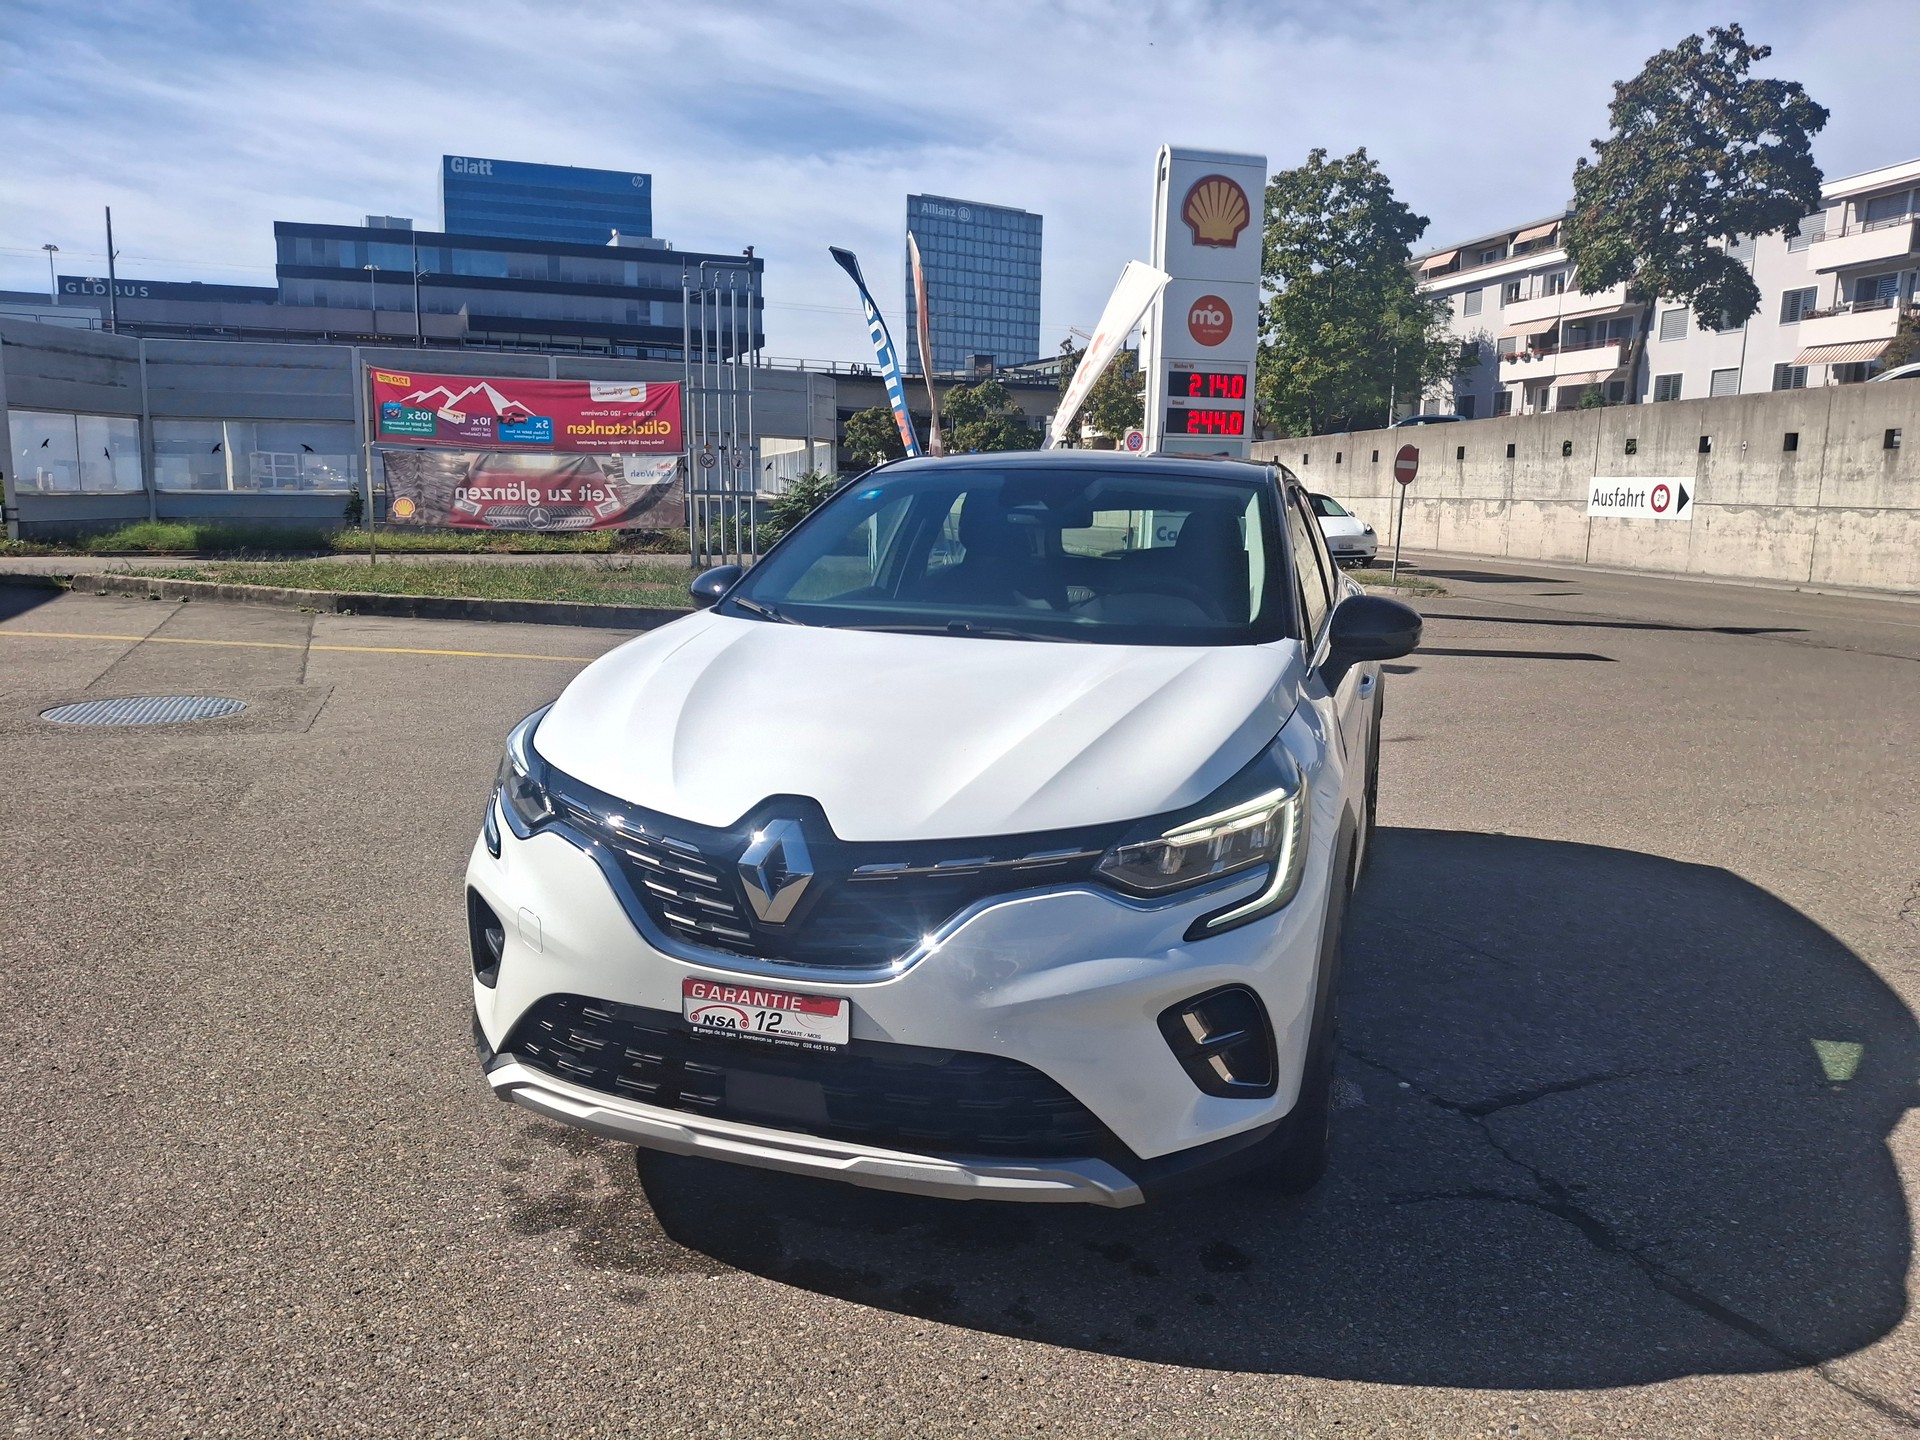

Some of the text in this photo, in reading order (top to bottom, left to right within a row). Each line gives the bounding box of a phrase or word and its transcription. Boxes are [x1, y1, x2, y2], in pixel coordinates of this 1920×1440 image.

[451, 157, 493, 176] Glatt
[632, 175, 644, 188] hp
[921, 202, 956, 217] Allianz
[1191, 304, 1225, 326] mio
[1187, 410, 1242, 435] 244.0
[1591, 487, 1645, 508] Ausfahrt
[691, 983, 803, 1011] GARANTIE
[703, 1014, 736, 1029] NSA
[755, 1010, 783, 1034] 12
[698, 1028, 713, 1036] garage
[743, 1034, 766, 1043] montavon
[775, 1038, 800, 1048] porrentruy
[780, 1029, 803, 1038] MONATE
